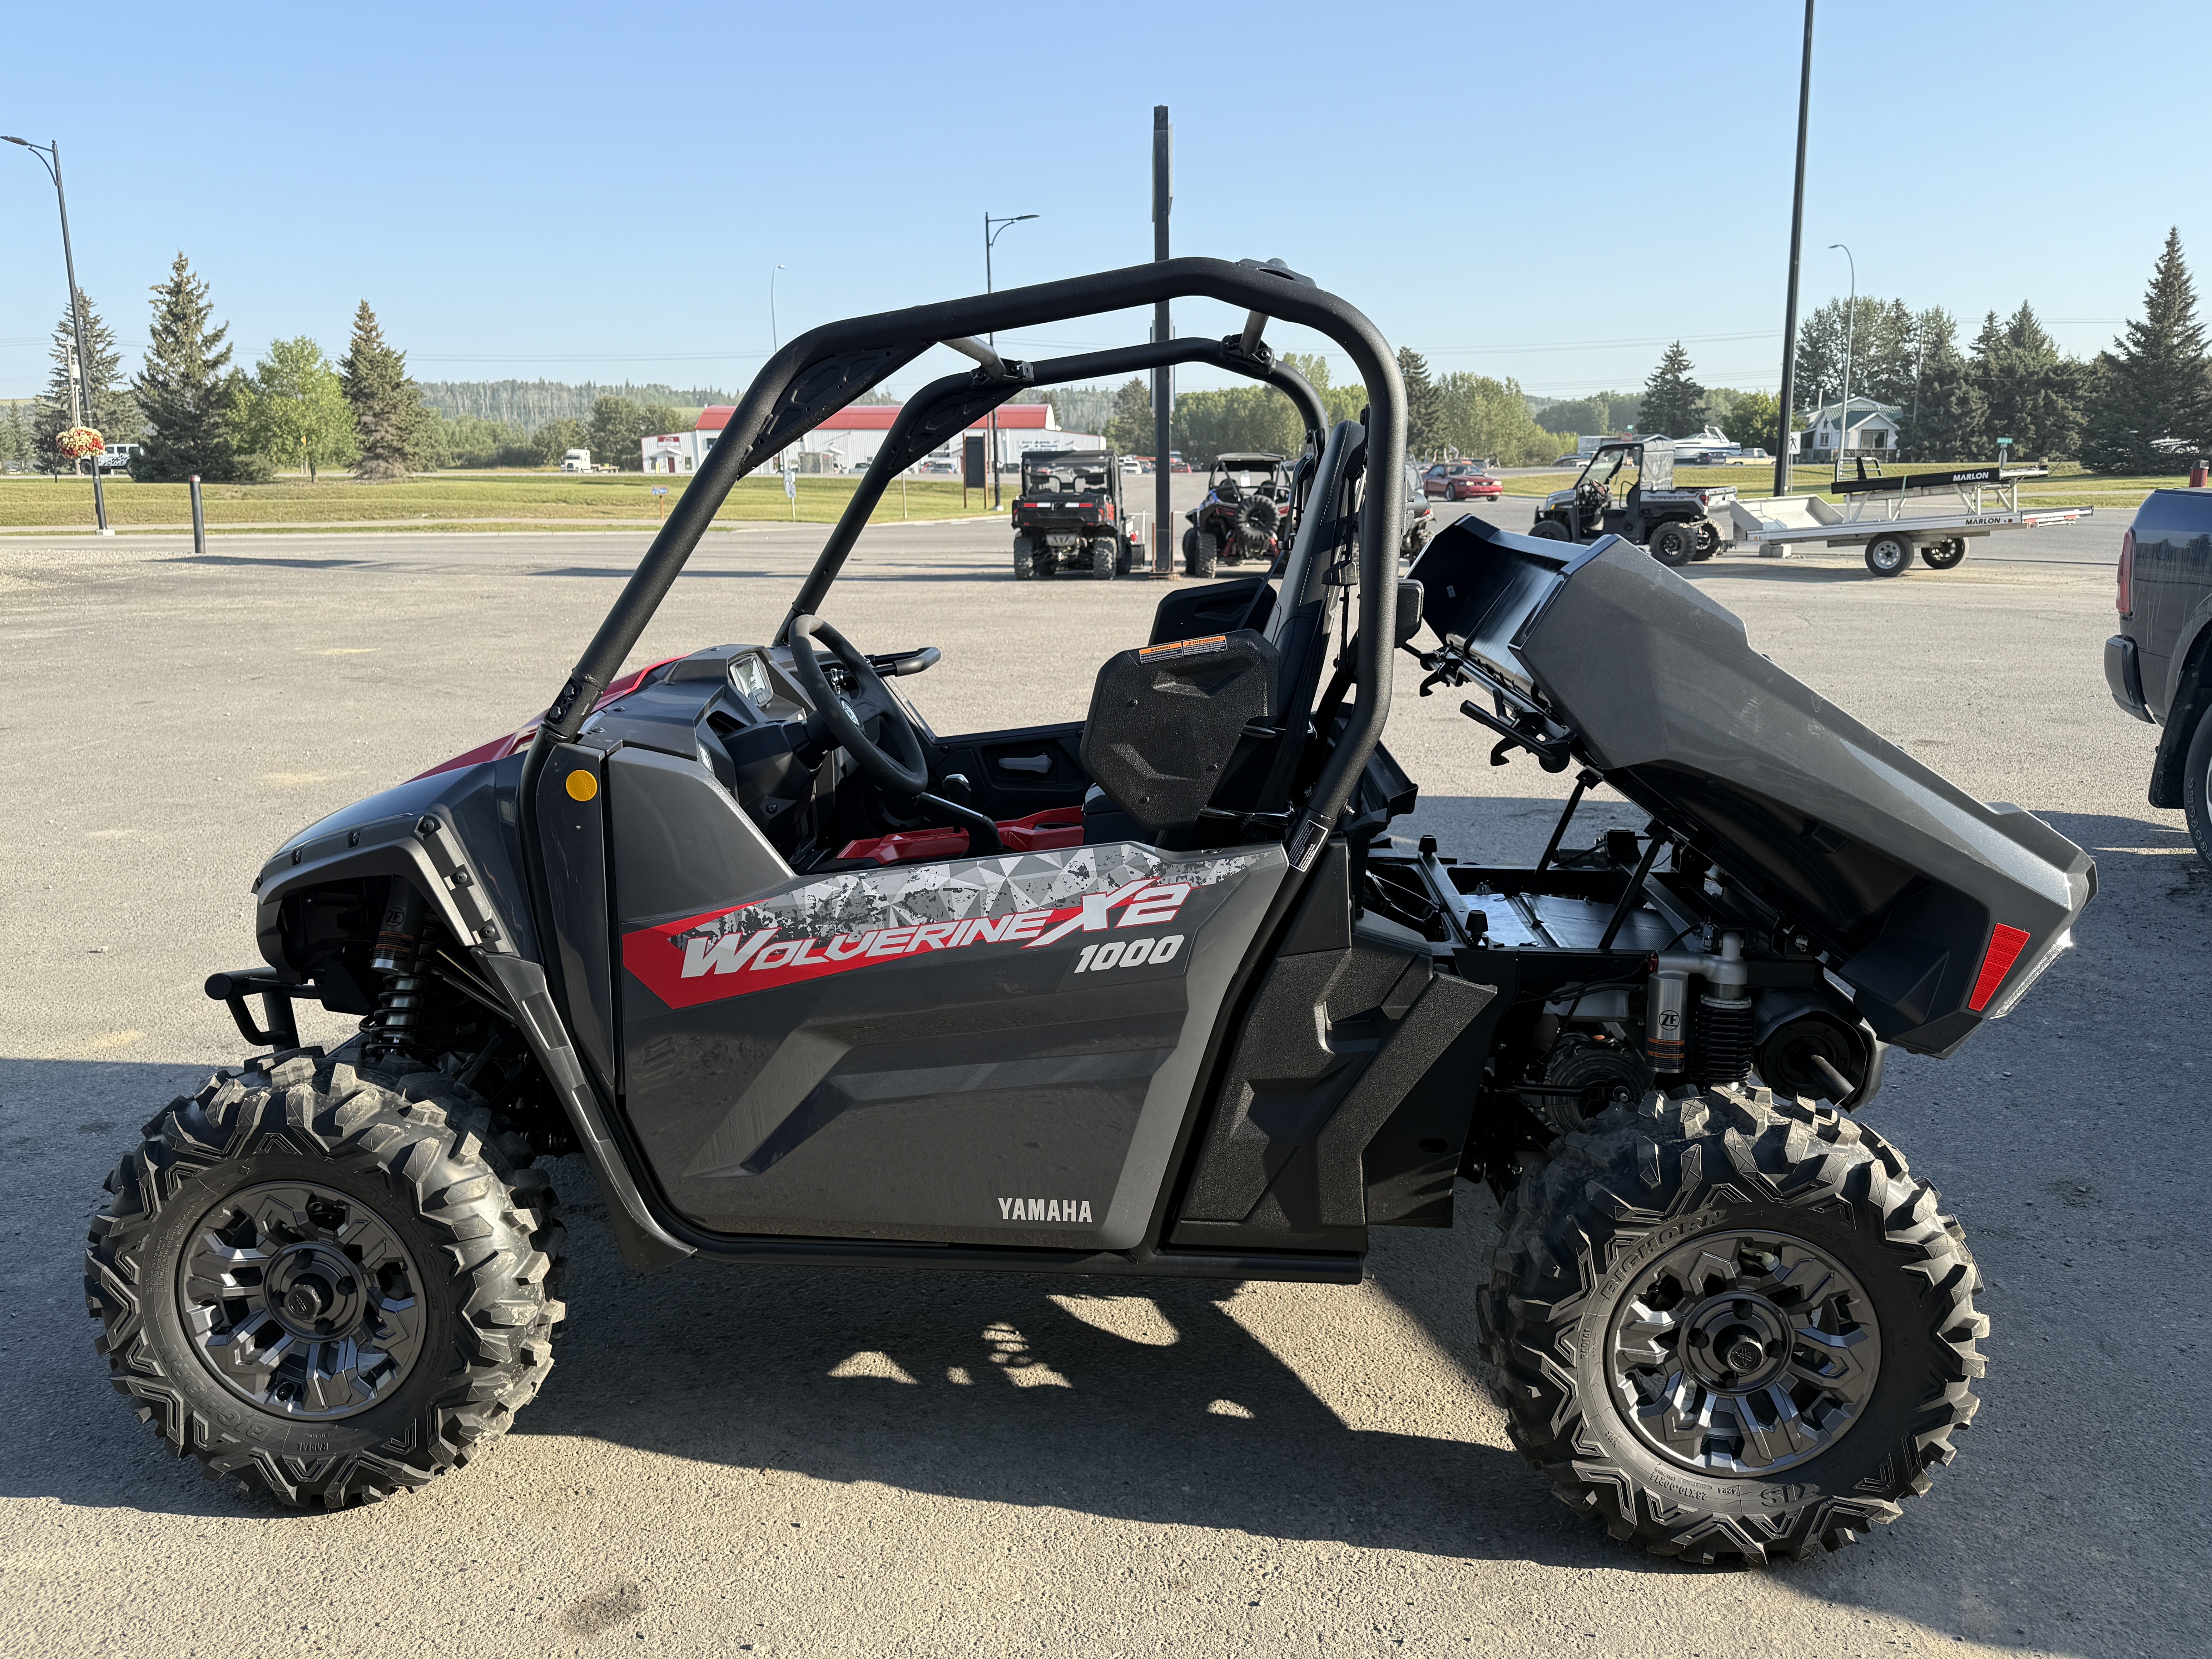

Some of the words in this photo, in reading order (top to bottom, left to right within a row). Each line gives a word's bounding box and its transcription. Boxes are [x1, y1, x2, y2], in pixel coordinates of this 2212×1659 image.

[1953, 472, 1989, 481] MARLON
[681, 908, 1055, 979] WOLVERINE
[1018, 877, 1192, 950] X2
[1074, 934, 1185, 974] 1000
[1661, 1013, 1679, 1027] ZF
[998, 1197, 1092, 1223] YAMAHA
[1600, 1209, 1726, 1300] BIGHORN
[158, 1345, 271, 1441] BIGHORN
[297, 1442, 329, 1452] RADIAL
